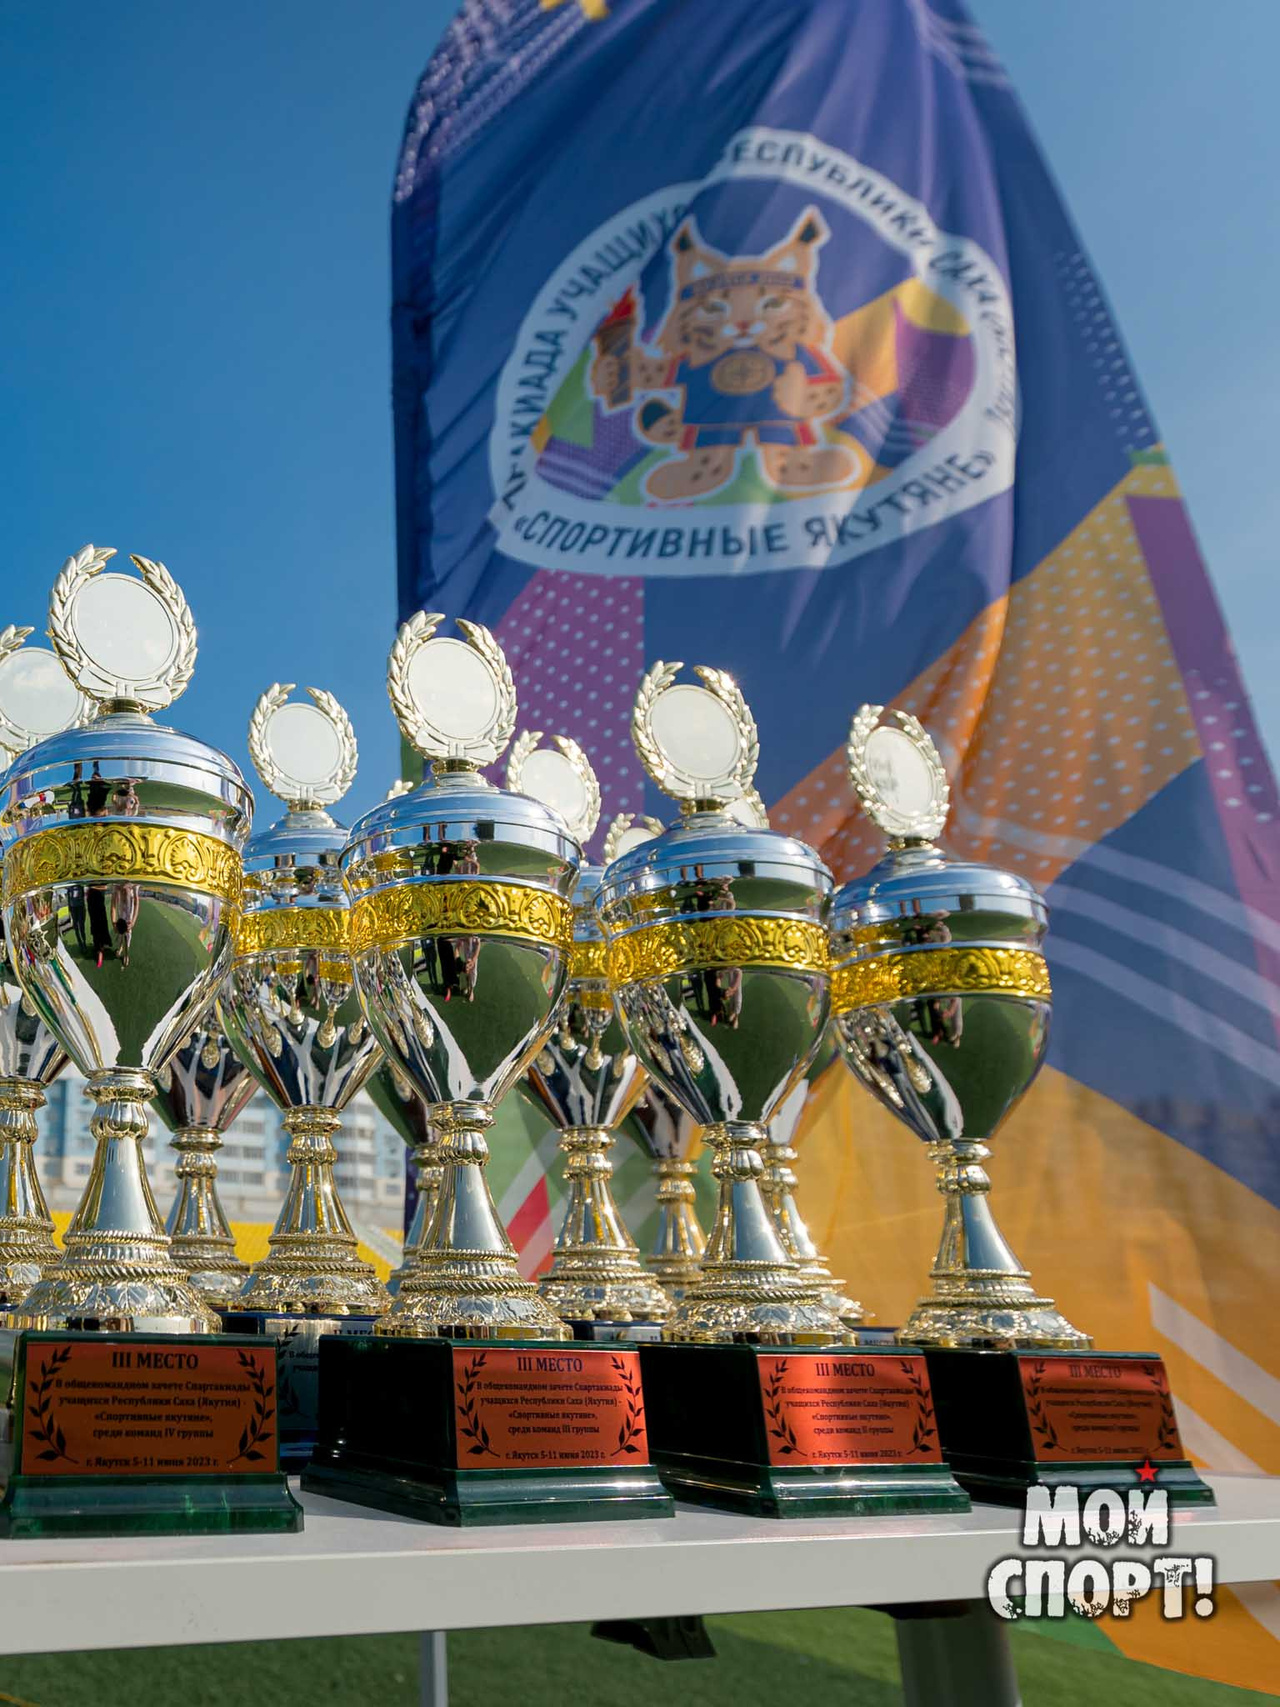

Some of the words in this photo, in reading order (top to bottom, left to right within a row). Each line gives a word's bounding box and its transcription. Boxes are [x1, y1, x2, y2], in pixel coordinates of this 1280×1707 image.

[514, 510, 791, 559] «СПОРТИВНЫЕ
[804, 450, 997, 549] ЯКУТЯНЕ»
[112, 1352, 131, 1368] III
[137, 1353, 198, 1369] МЕСТО
[517, 1357, 532, 1371] III
[536, 1358, 582, 1372] МЕСТО
[815, 1363, 829, 1376] III
[833, 1363, 875, 1376] МЕСТО
[1083, 1365, 1121, 1378] МЕСТО
[165, 1428, 175, 1437] IV
[541, 1451, 556, 1459] 5-11
[581, 1451, 599, 1459] 2023
[95, 1456, 130, 1468] Якутск
[133, 1457, 154, 1466] 5-11
[187, 1456, 210, 1466] 2023
